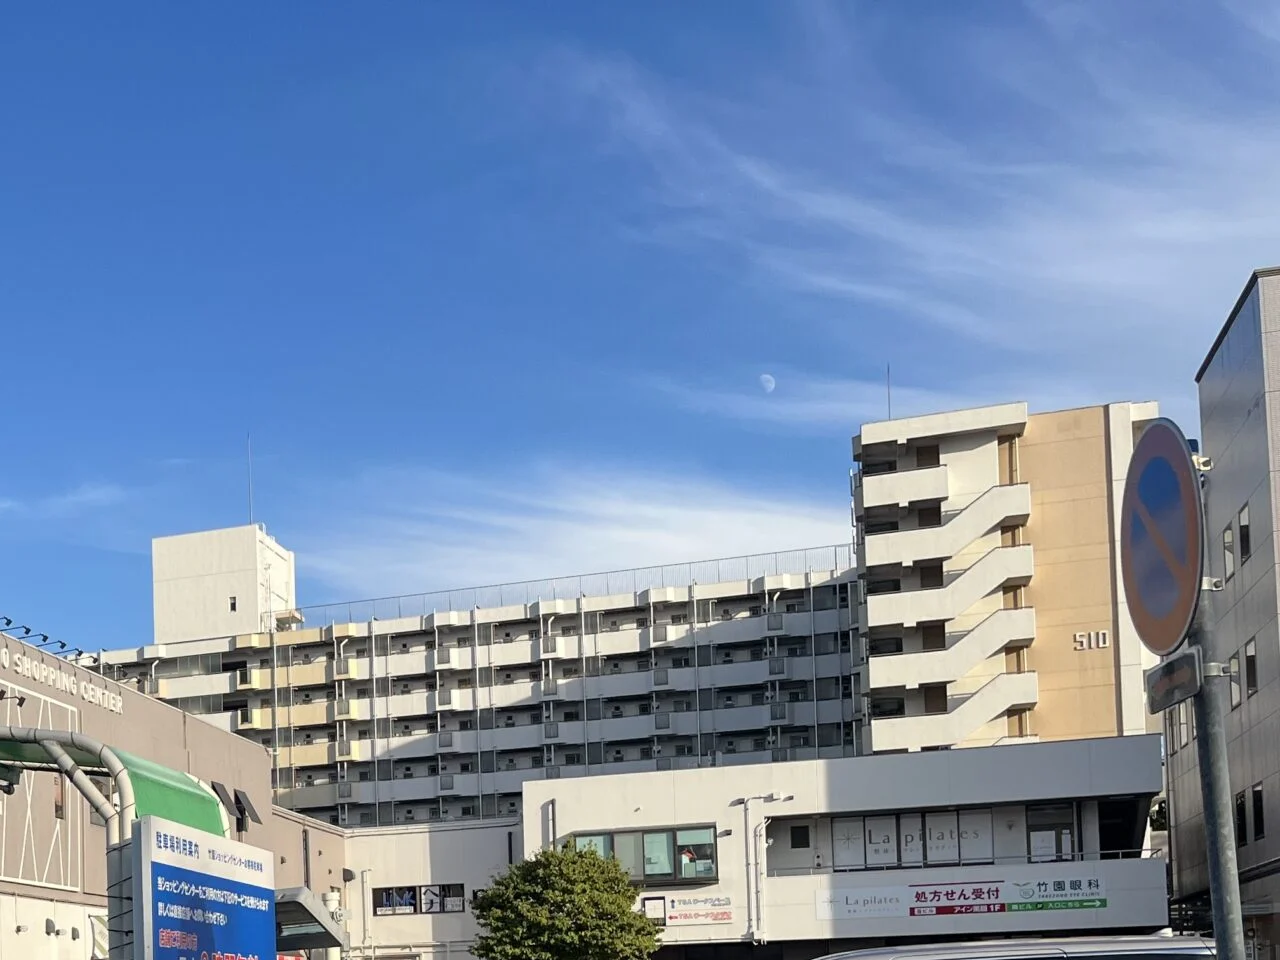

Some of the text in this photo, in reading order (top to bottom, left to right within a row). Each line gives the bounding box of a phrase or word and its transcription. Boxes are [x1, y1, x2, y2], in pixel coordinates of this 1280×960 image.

[1073, 630, 1109, 651] 510
[13, 652, 78, 697] SHOPPING
[80, 680, 124, 715] CENTER
[156, 831, 200, 859] 駐車場利用案内
[868, 828, 891, 845] La
[1037, 879, 1100, 893] 竹園眼科
[845, 894, 900, 908] La pilates
[914, 887, 1000, 903] 処方せん受付
